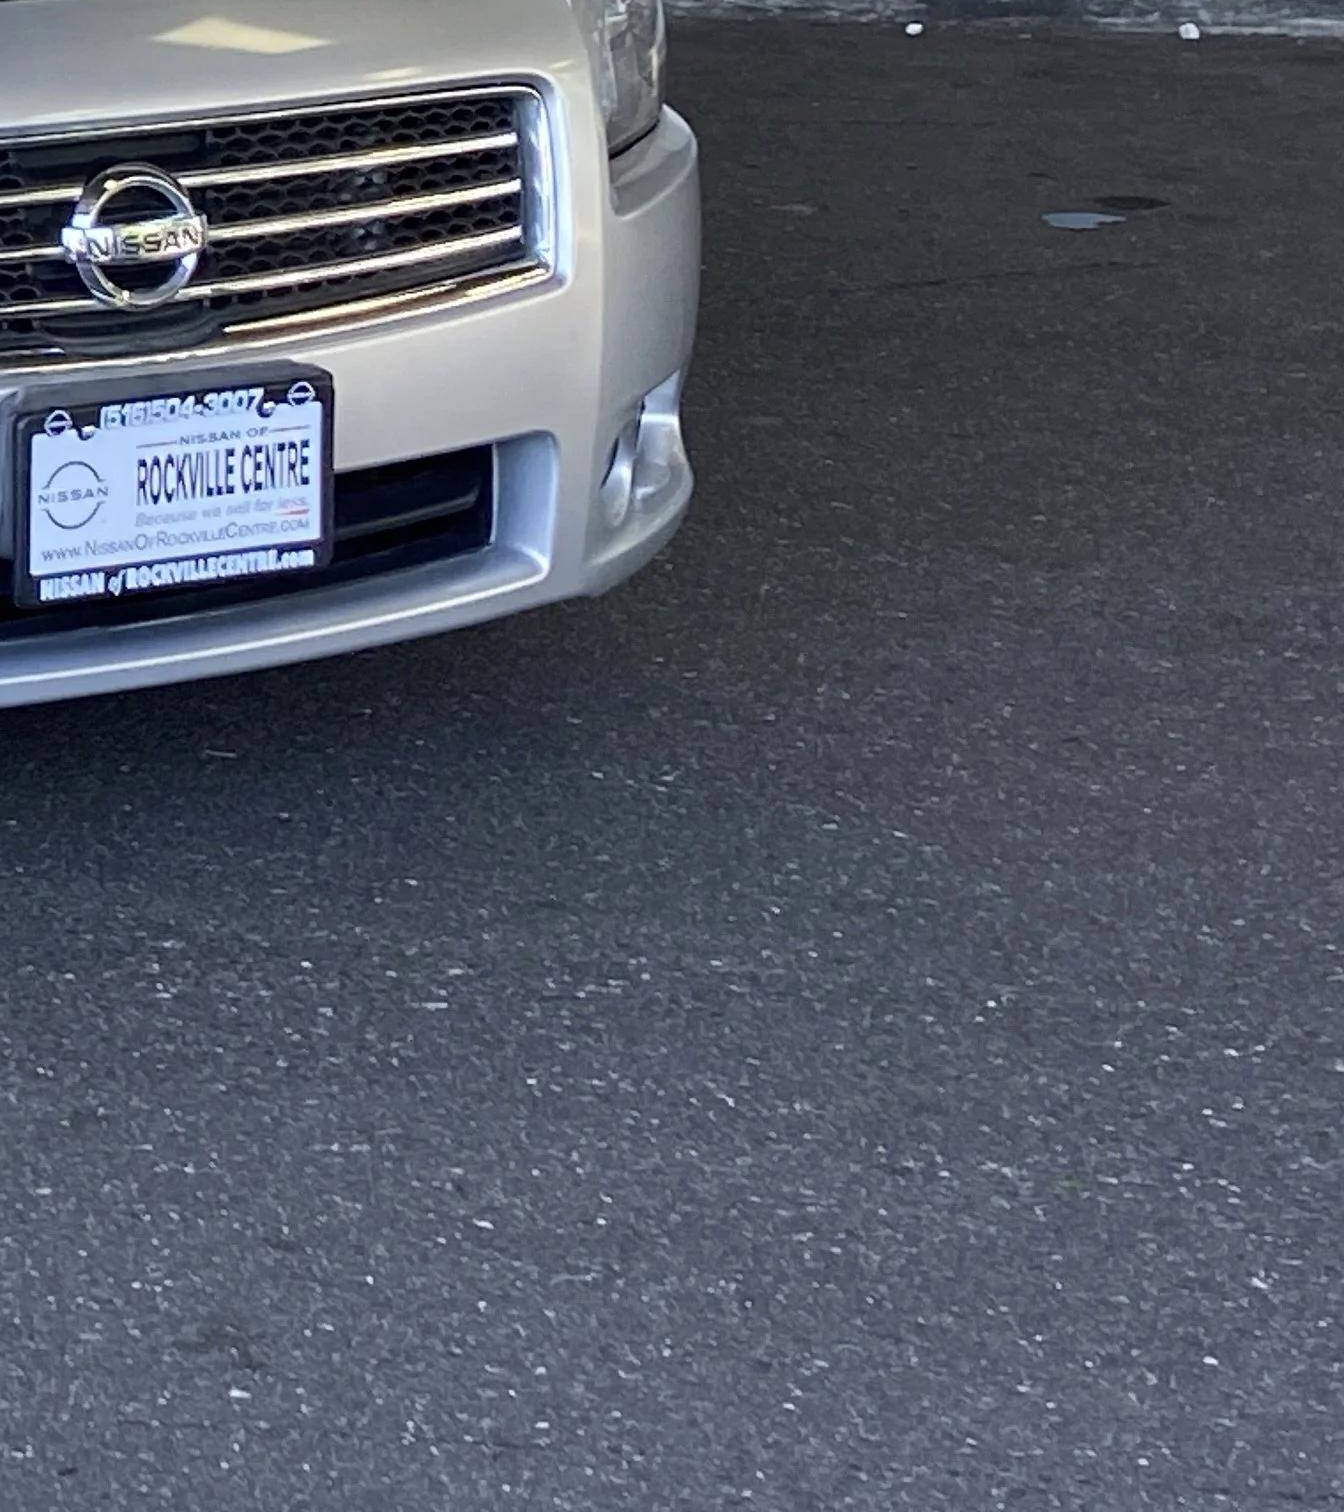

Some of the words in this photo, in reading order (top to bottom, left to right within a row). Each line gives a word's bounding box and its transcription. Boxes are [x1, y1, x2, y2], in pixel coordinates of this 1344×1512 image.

[86, 225, 202, 258] NISSAN
[136, 447, 235, 507] ROCKVILLE
[240, 438, 311, 495] CENTRE
[37, 487, 109, 505] NISSAN
[40, 571, 106, 602] NISSAN
